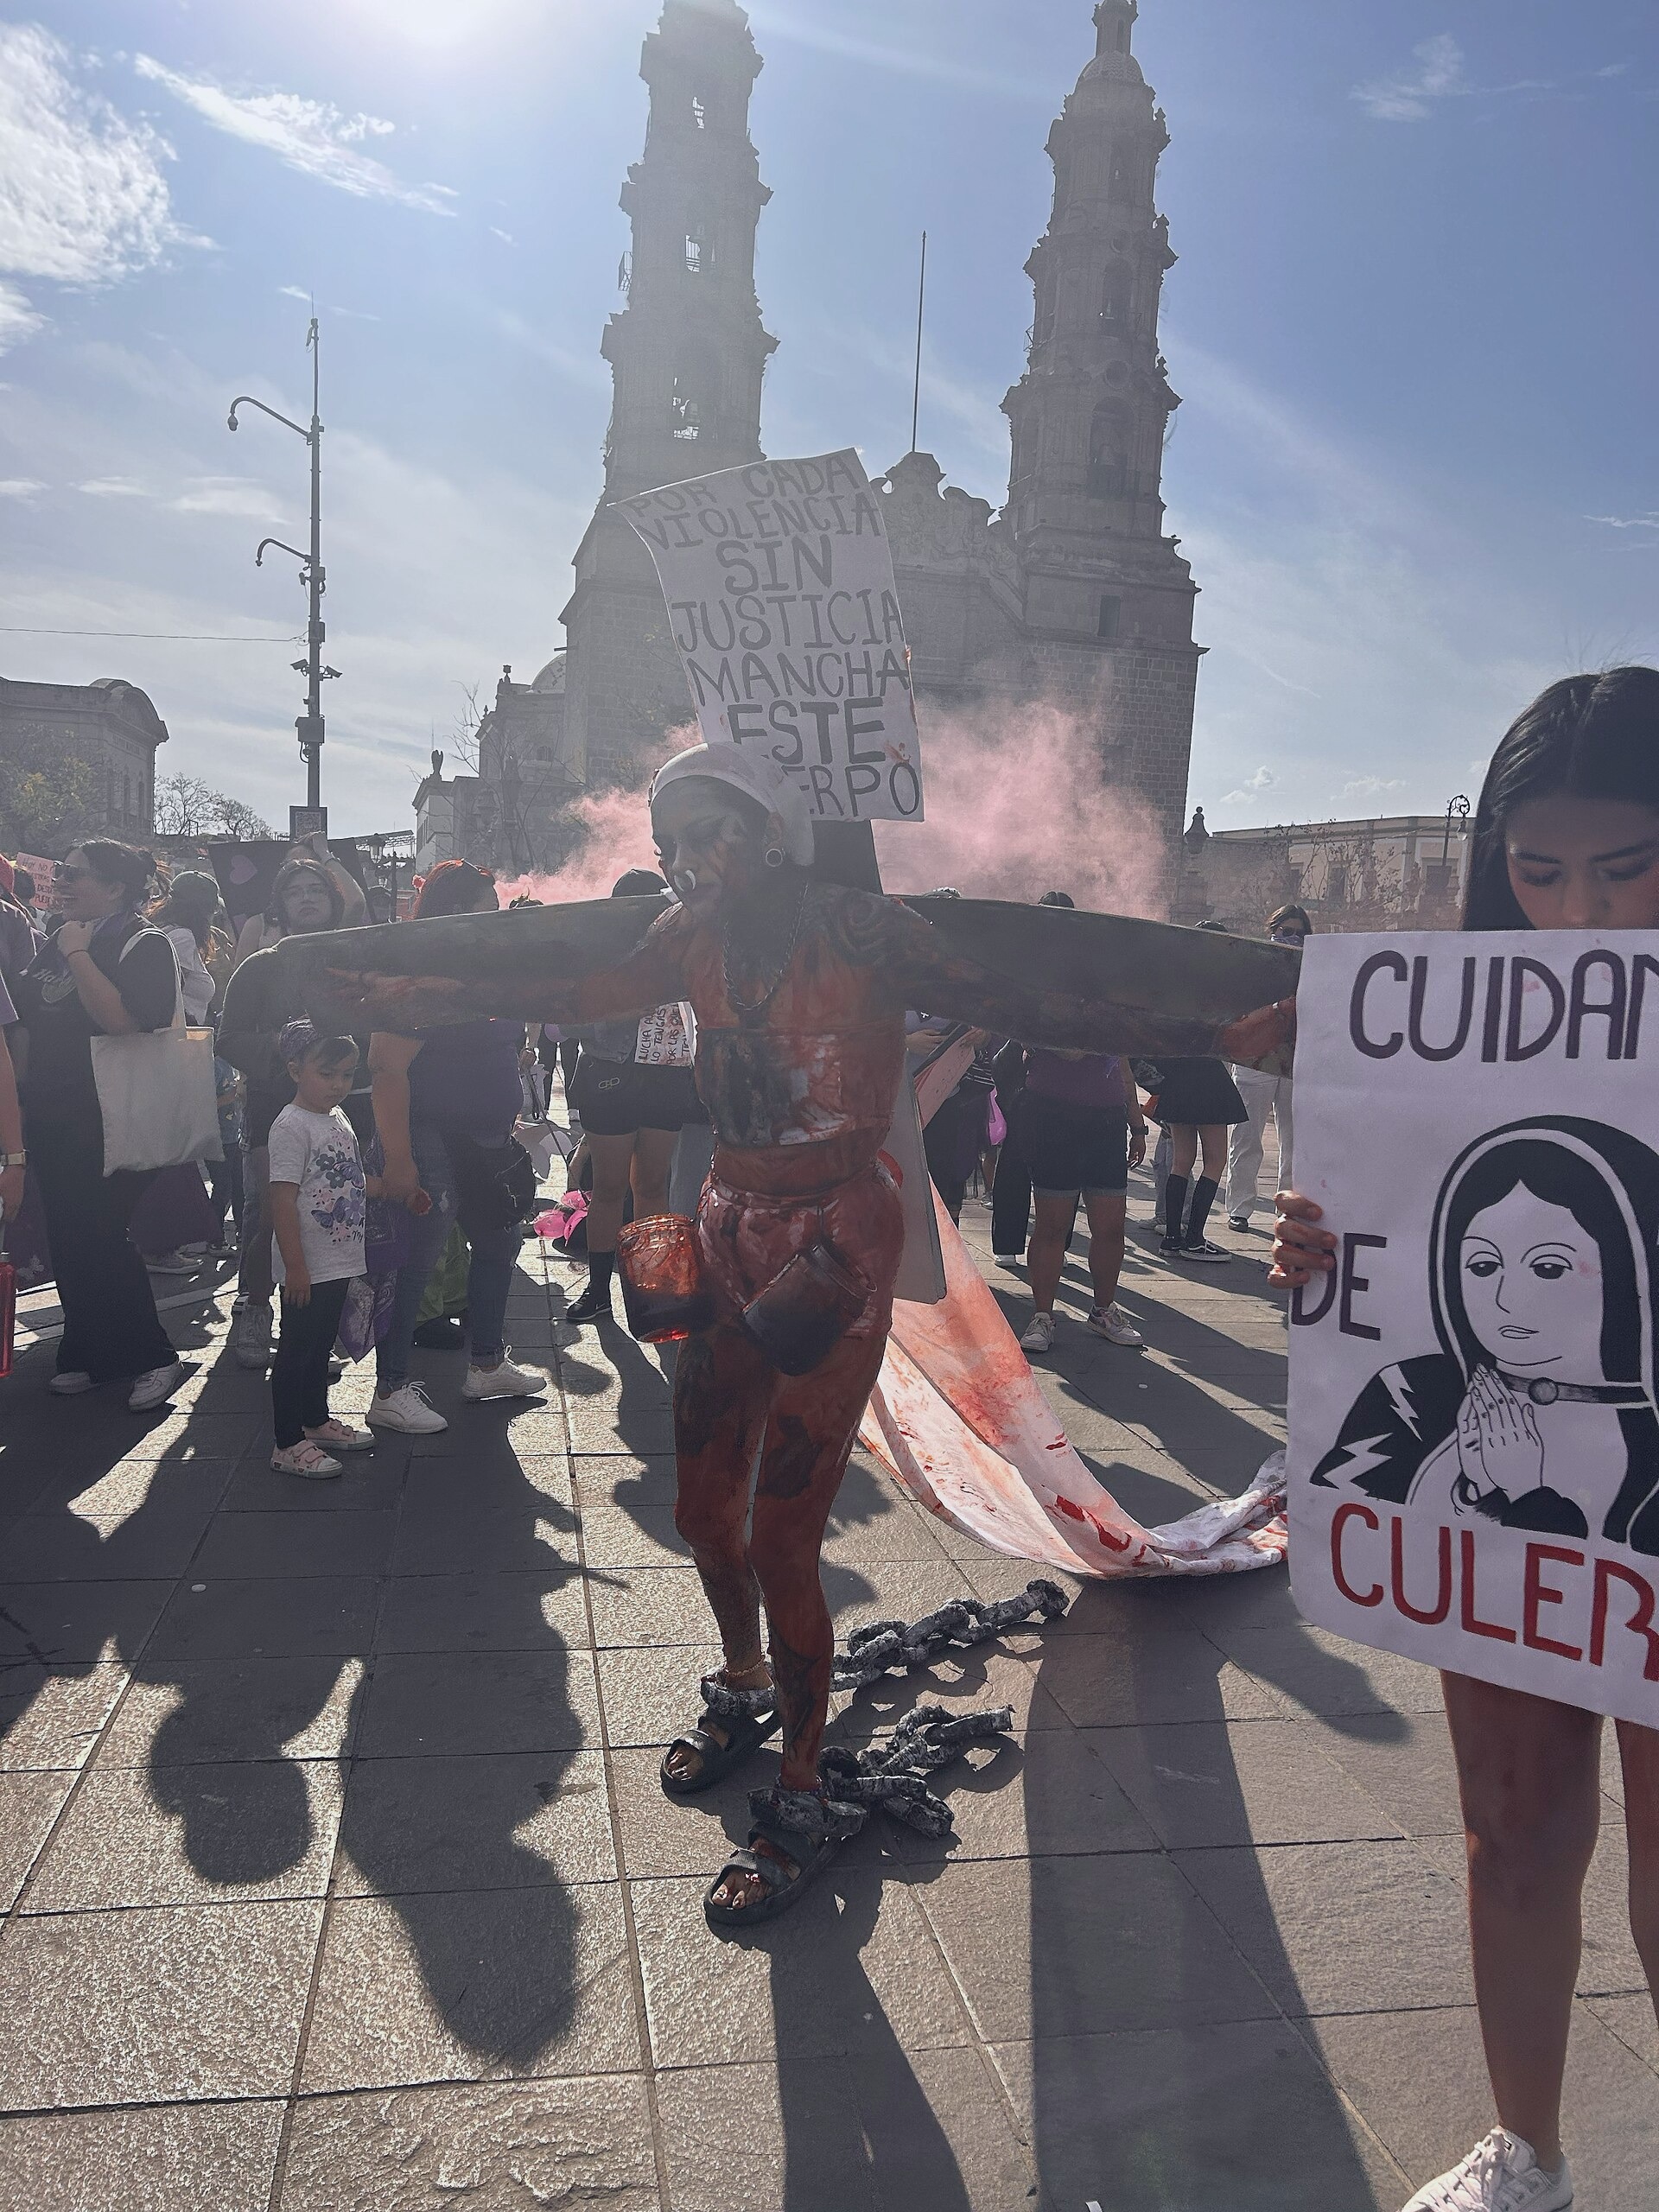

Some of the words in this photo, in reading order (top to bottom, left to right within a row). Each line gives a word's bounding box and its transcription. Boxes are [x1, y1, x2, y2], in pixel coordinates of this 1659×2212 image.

[625, 481, 718, 518] POR
[741, 455, 861, 499] CADA
[633, 492, 881, 550] VIOLENCIA
[715, 534, 834, 596] SIN
[671, 588, 905, 653] JUSTICIA
[686, 648, 910, 707] MANCHA
[727, 696, 887, 766] ESTE
[639, 1029, 652, 1061] LUCHA
[654, 1007, 666, 1046] TENGAS
[668, 1028, 680, 1046] LAS
[651, 1052, 661, 1062] LO
[666, 1048, 677, 1065] POR
[1291, 1232, 1388, 1341] DE
